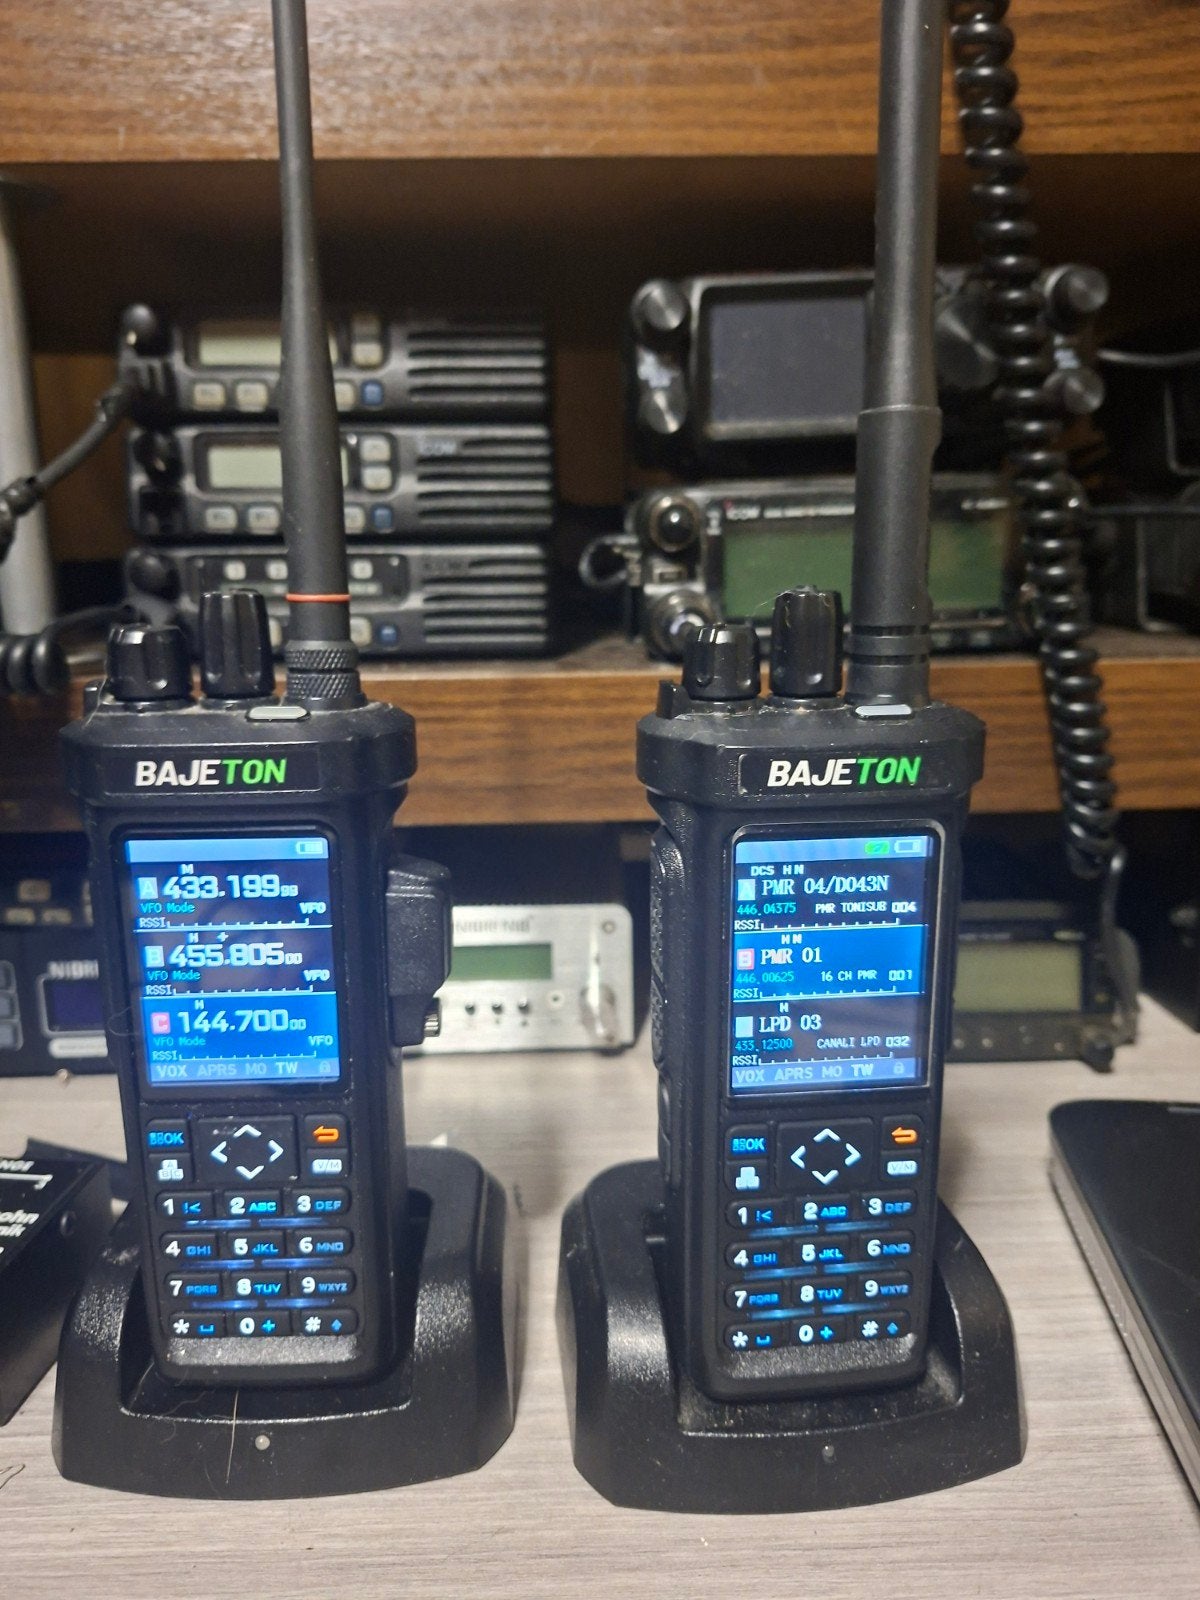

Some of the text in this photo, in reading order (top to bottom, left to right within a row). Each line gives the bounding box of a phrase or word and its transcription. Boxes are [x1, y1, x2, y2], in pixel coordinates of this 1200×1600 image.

[135, 757, 287, 786] BAJETON
[767, 756, 922, 787] BAJETON
[181, 864, 194, 874] M
[751, 865, 775, 876] DCS
[761, 878, 795, 895] PMR
[141, 902, 195, 913] VFO Mode
[299, 902, 326, 914] VFO
[815, 902, 836, 914] PMR
[139, 917, 166, 927] RSSI
[734, 919, 760, 930] RSSI
[760, 948, 793, 965] PMR
[802, 946, 822, 963] 01
[148, 969, 201, 981] VFO Mode
[304, 970, 330, 981] VFO
[821, 969, 878, 982] 16 CH PMR
[888, 969, 913, 981] 001
[145, 985, 172, 996] RSSI
[733, 988, 759, 999] RSSI
[759, 1016, 792, 1033] LPD
[800, 1014, 821, 1031] 03
[153, 1036, 206, 1047] VFO Mode
[308, 1035, 334, 1046] VFO
[816, 1036, 881, 1049] CANALI LPD
[885, 1036, 911, 1048] 032
[152, 1050, 178, 1061] RSSI
[732, 1055, 758, 1066] RSSI
[156, 1065, 187, 1078] VOX
[196, 1063, 237, 1076] APRS
[275, 1062, 299, 1074] TW
[735, 1069, 764, 1083] VOX
[775, 1067, 813, 1081] APRS
[851, 1063, 873, 1077] TW
[164, 1132, 185, 1146] OK
[746, 1138, 766, 1151] OK
[164, 1199, 174, 1215] 1
[230, 1197, 276, 1214] 2 ABC
[297, 1195, 341, 1213] 3 DEF
[804, 1202, 846, 1220] 2 ABC
[868, 1198, 912, 1215] 3 DEF
[738, 1207, 748, 1225] 1
[166, 1240, 211, 1257] 4 GHI
[234, 1238, 278, 1255] 5 JKL
[299, 1237, 313, 1253] 6
[802, 1244, 844, 1262] 5 JKL
[867, 1239, 881, 1257] 6
[734, 1250, 777, 1267] 4 GHI
[169, 1280, 182, 1296] 7
[237, 1278, 281, 1295] 8 TUV
[302, 1277, 347, 1293] 9 WXYZ
[865, 1280, 909, 1297] 9 WXYZ
[735, 1290, 748, 1308] 7
[800, 1285, 842, 1302] 8 TUV
[240, 1318, 255, 1333] 0
[305, 1316, 321, 1332] #
[799, 1325, 813, 1342] 0
